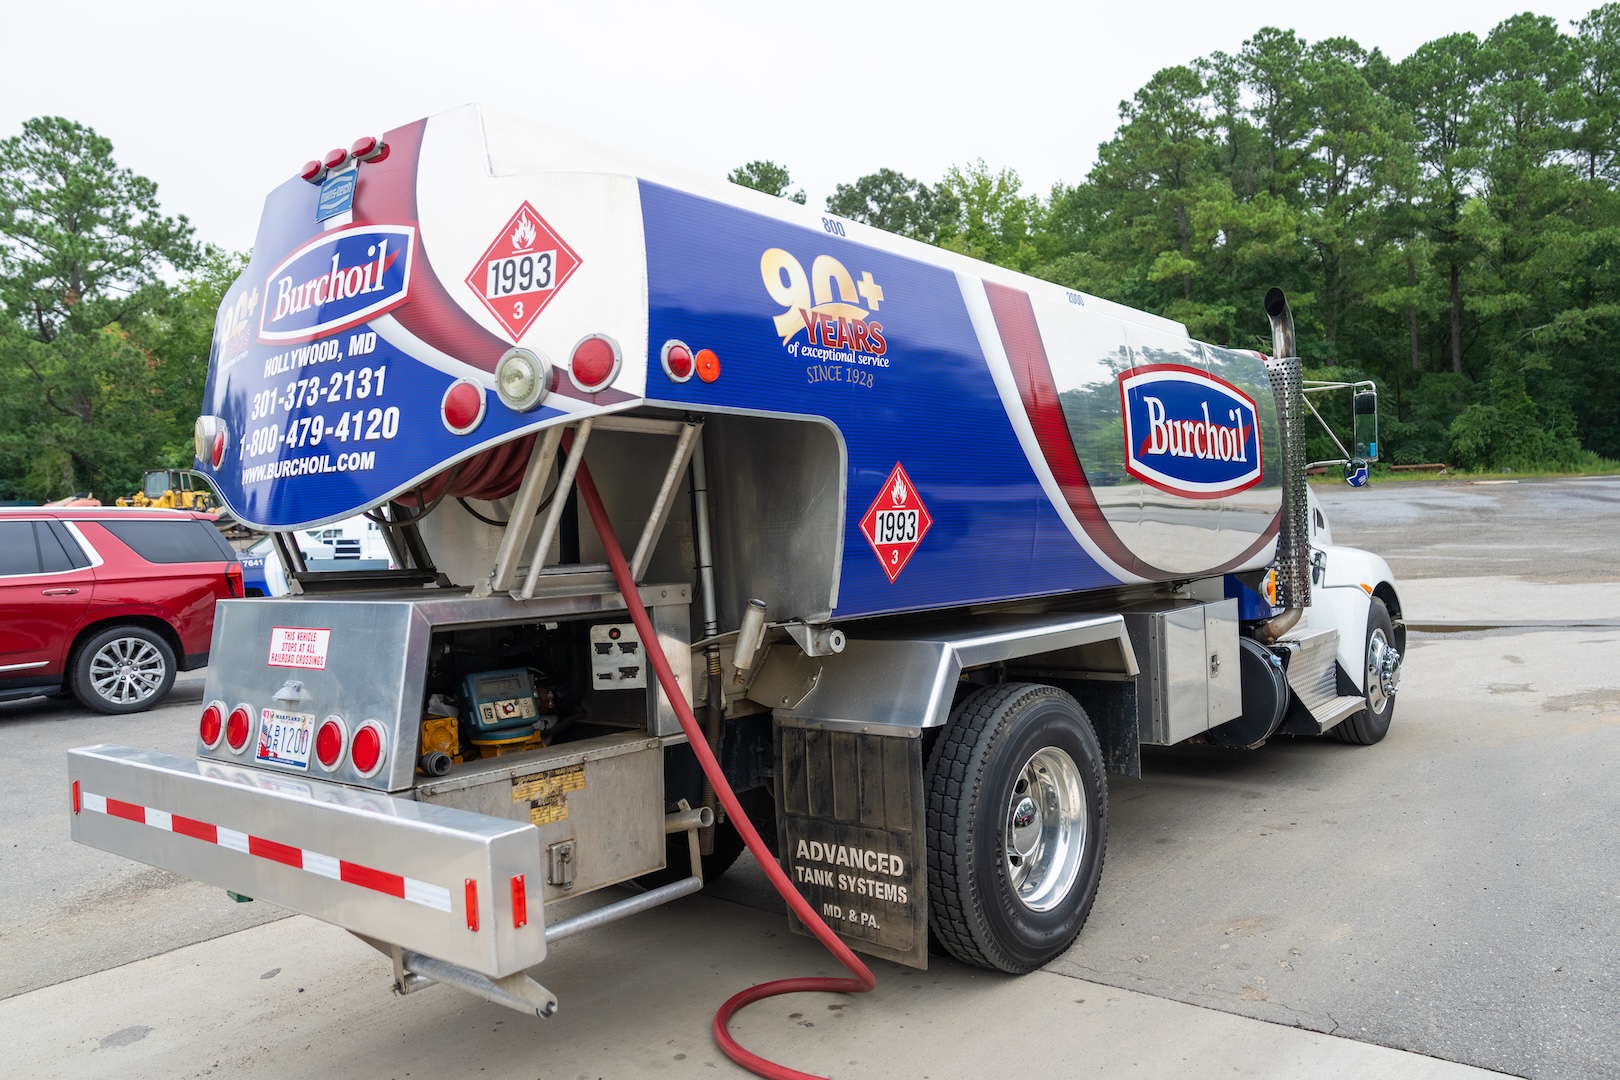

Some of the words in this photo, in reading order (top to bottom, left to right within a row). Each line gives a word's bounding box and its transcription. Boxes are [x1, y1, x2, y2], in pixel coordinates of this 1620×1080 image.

[822, 217, 845, 237] 800
[272, 239, 388, 322] Burchoil
[491, 253, 551, 295] 1993
[512, 301, 524, 319] 3
[798, 307, 887, 356] YEARS
[264, 339, 342, 378] HOLLYWOOD,
[348, 332, 377, 356] MD
[787, 342, 800, 357] of
[801, 345, 856, 363] exceptional
[857, 354, 890, 367] service
[806, 365, 842, 384] SINCE
[846, 367, 874, 388] 1928
[252, 365, 386, 421] 301-373-2131
[239, 406, 400, 461] 1-800-479-4120
[1143, 396, 1247, 462] Burchoil
[241, 451, 375, 485] WWW.BURCHOIL.COM
[878, 511, 916, 542] 1993
[243, 559, 263, 567] 7641
[891, 549, 899, 565] 3
[282, 642, 297, 652] STOPS
[298, 643, 305, 652] AT
[306, 643, 315, 653] ALL
[285, 631, 295, 641] THIS
[297, 632, 317, 642] VEHICLE
[271, 653, 295, 664] RAILROAD
[296, 654, 324, 666] CROSSINGS
[796, 839, 904, 877] ADVANCED
[795, 865, 834, 888] TANK
[838, 874, 907, 904] SYSTEMS
[823, 903, 845, 920] MD.
[848, 909, 858, 923] &
[861, 912, 880, 929] PA.
